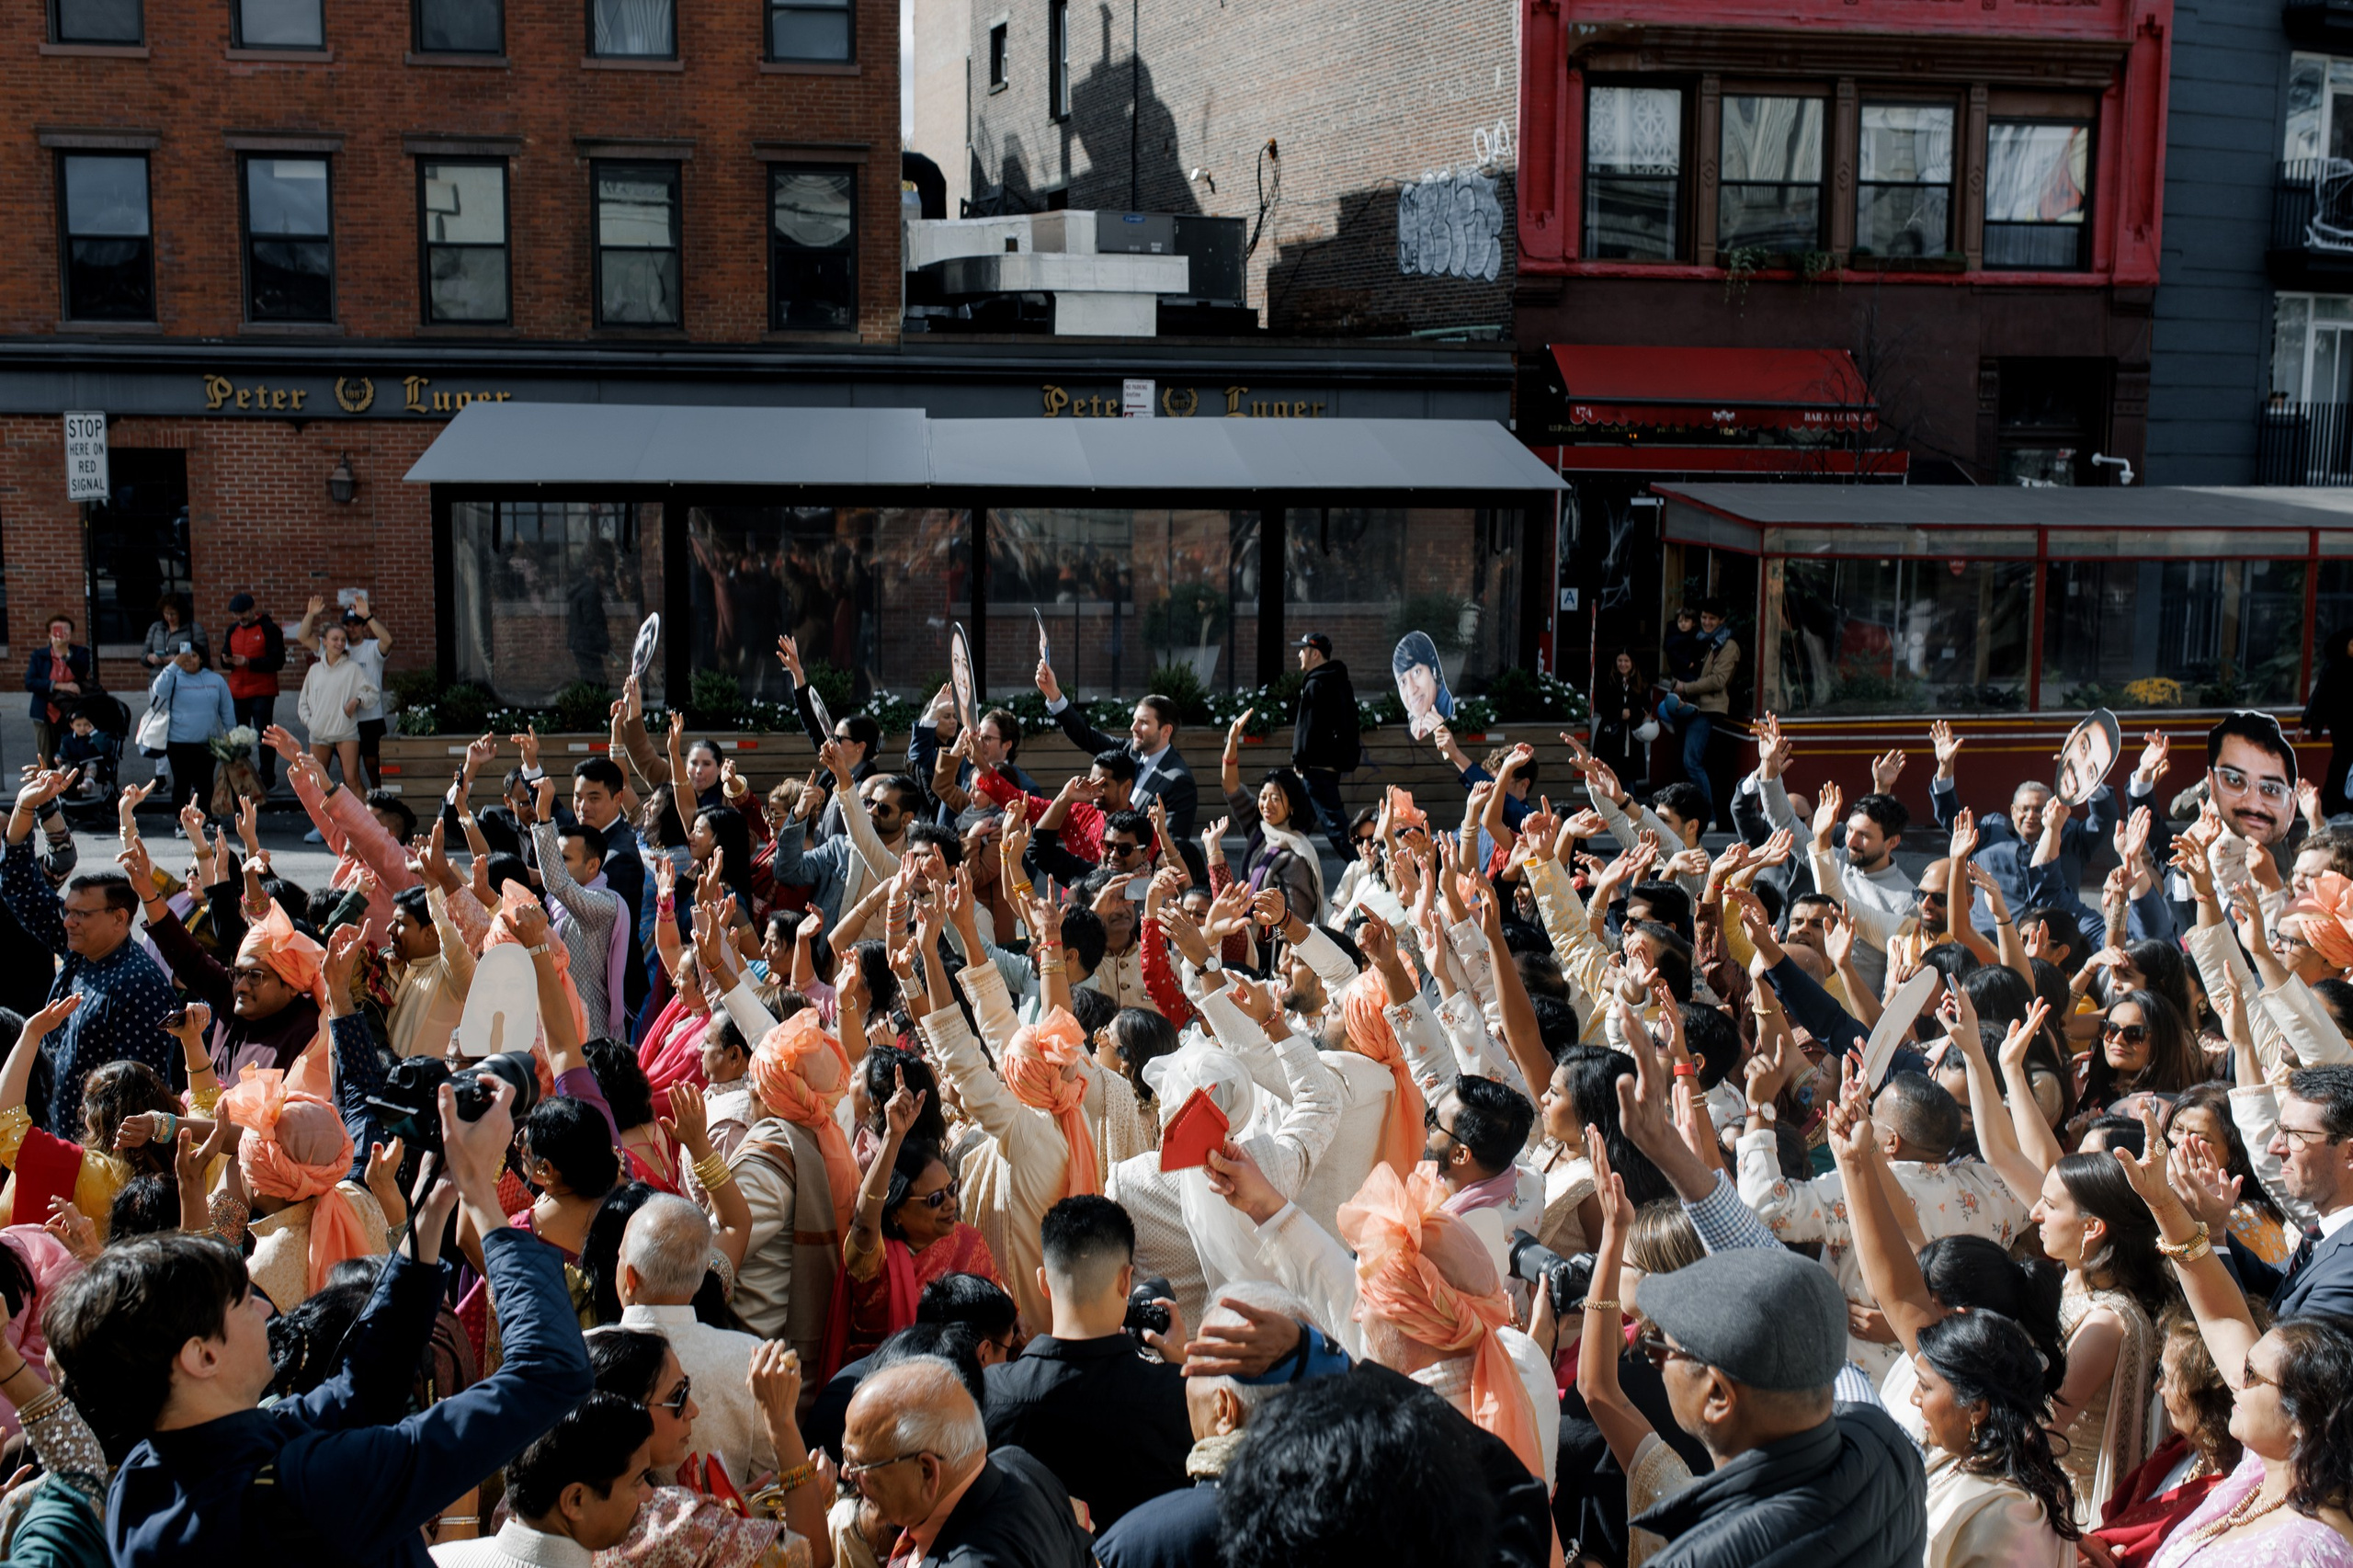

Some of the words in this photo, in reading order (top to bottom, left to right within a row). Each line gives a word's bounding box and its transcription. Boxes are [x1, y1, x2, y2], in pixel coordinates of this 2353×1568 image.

[202, 374, 307, 410] Peter
[346, 390, 365, 399] 1887
[1042, 384, 1118, 417] Pete
[1575, 406, 1592, 418] 174
[1804, 412, 1822, 422] BAR
[1824, 413, 1830, 422] &
[69, 419, 103, 437] STOP
[69, 442, 90, 456] HERE
[93, 442, 104, 455] ON
[78, 460, 97, 473] RED
[72, 478, 105, 492] SIGNAL
[1564, 591, 1574, 604] A
